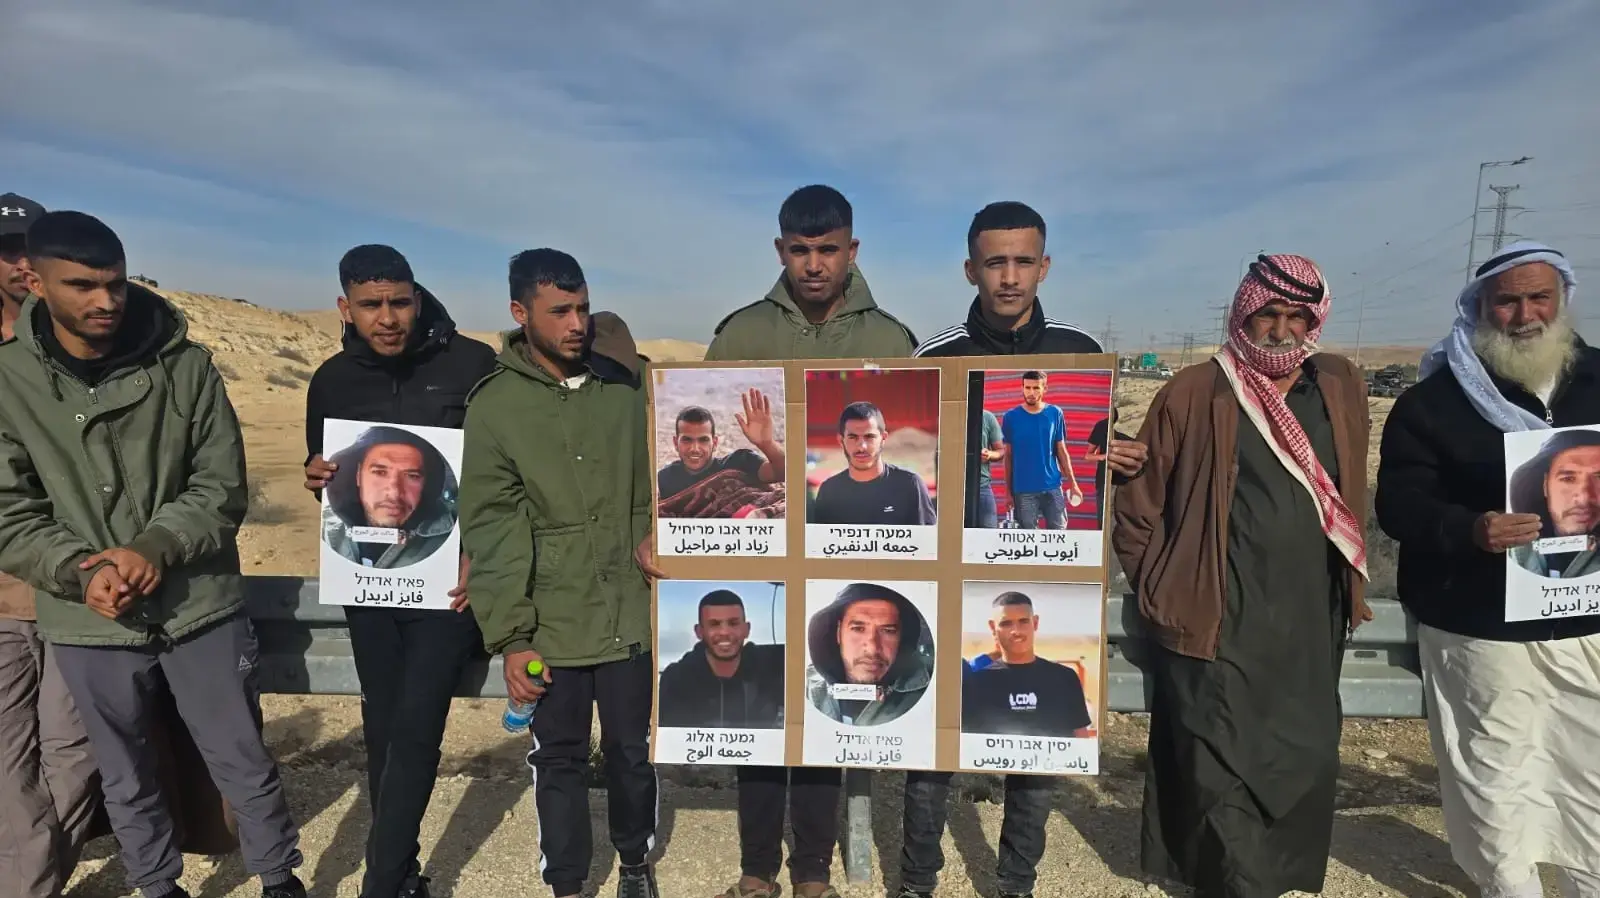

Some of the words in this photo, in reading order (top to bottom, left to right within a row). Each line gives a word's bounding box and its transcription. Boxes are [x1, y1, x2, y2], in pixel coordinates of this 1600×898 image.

[669, 522, 714, 534] מריחיל
[719, 526, 740, 534] אבו
[746, 526, 774, 535] זאיד
[830, 529, 870, 537] דנפירי
[876, 529, 911, 539] גמעה
[999, 533, 1035, 543] אטוחי
[1040, 534, 1065, 543] איוב
[675, 539, 720, 553] مراحيل
[725, 539, 740, 554] ابو
[746, 539, 768, 554] زياد
[823, 541, 877, 557] الدنفيري
[883, 543, 918, 556] جمعه
[1043, 542, 1077, 561] أيوب
[985, 545, 1037, 563] اطويحي
[355, 573, 391, 586] אדידל
[396, 578, 424, 587] פאיז
[1542, 586, 1579, 597] אדידל
[1585, 585, 1600, 594] איז
[355, 589, 393, 604] اديدل
[397, 591, 423, 606] فايز
[1541, 599, 1581, 617] اديدل
[1585, 600, 1599, 613] يز
[686, 730, 714, 742] אלוג
[720, 734, 754, 744] גמעה
[836, 731, 871, 744] אדידל
[876, 736, 902, 745] פאיז
[986, 739, 1013, 748] רויס
[1019, 740, 1042, 750] אבו
[1048, 741, 1071, 754] יסין
[687, 745, 712, 762] الوج
[718, 748, 752, 761] جمعه
[836, 748, 872, 764] اديدل
[877, 749, 901, 765] فايز
[974, 757, 1015, 768] رويس
[1021, 755, 1037, 769] ابو
